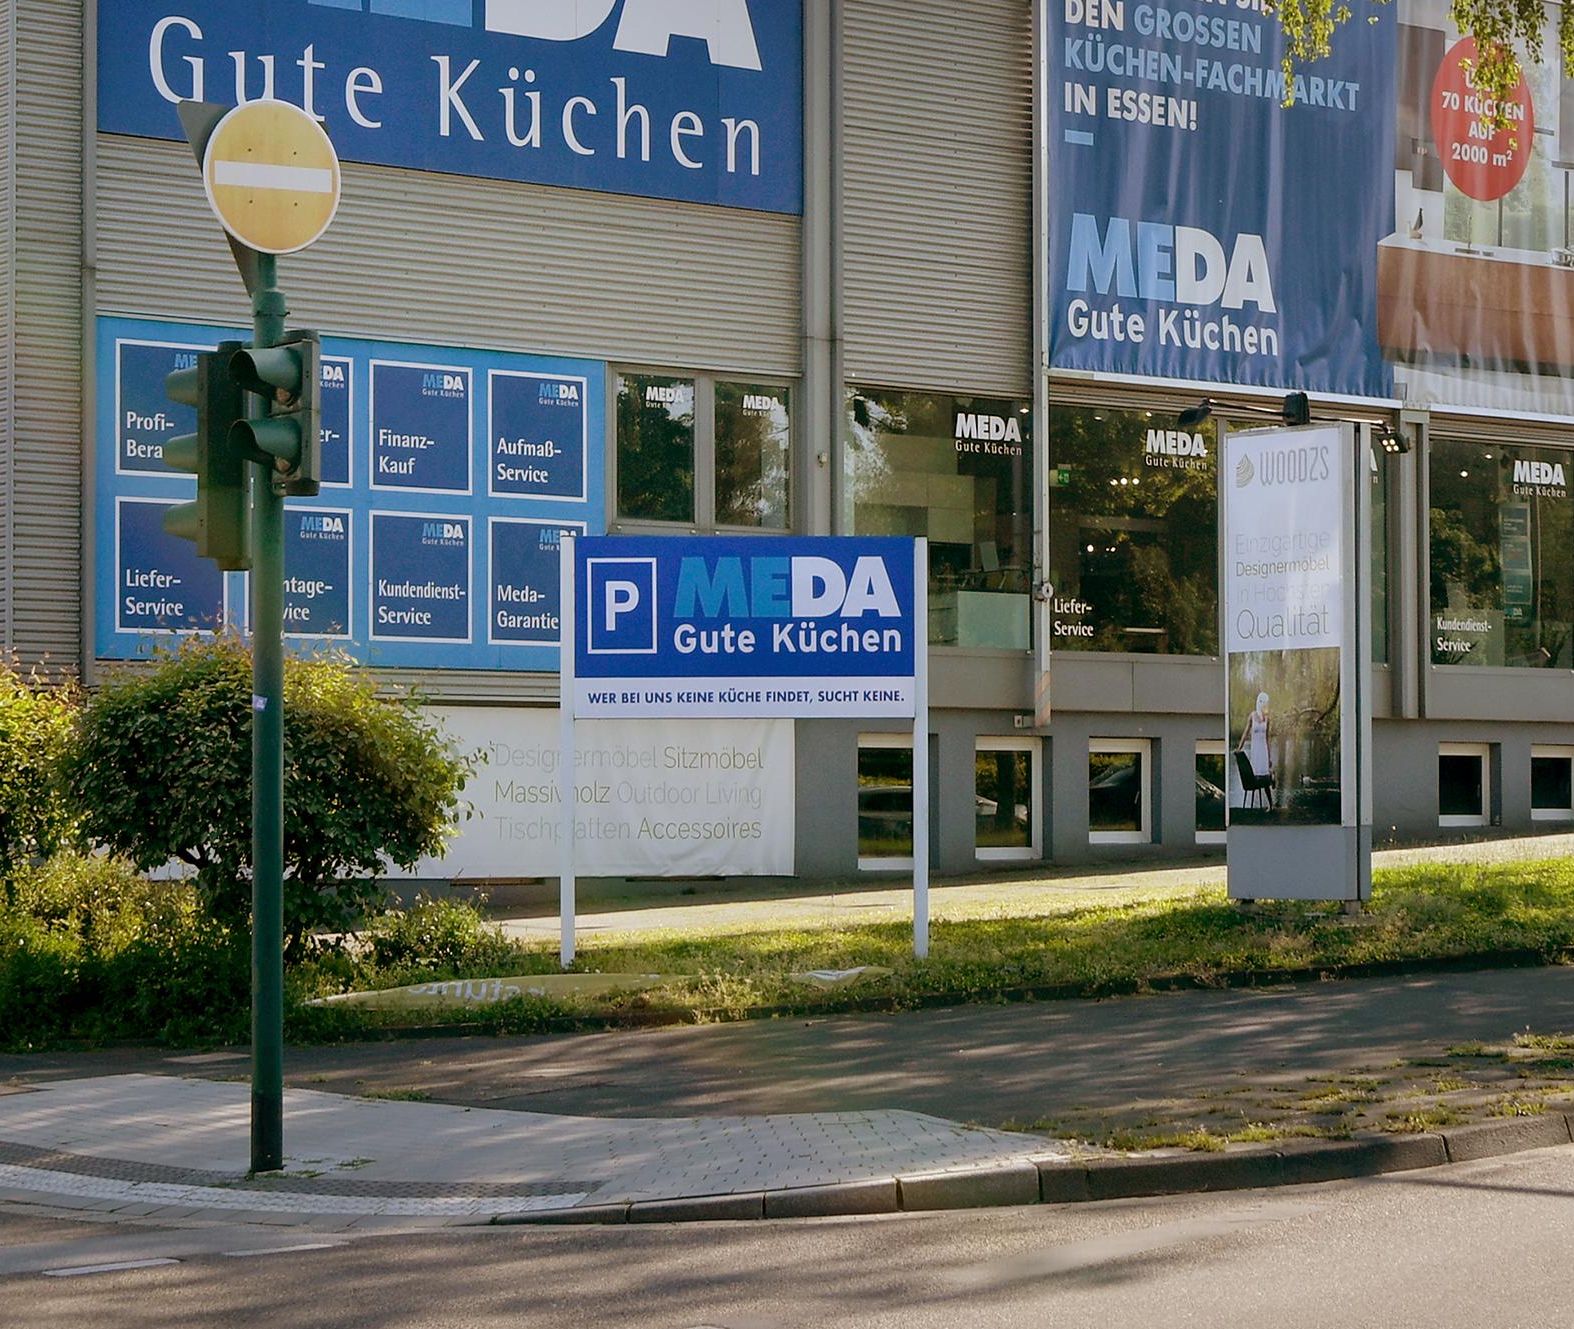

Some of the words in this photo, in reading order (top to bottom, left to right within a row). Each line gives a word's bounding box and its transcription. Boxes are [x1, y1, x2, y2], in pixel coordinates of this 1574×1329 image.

[1134, 4, 1261, 54] GROSSEN
[1065, 33, 1360, 112] KÜCHEN-FACHMARKT
[149, 15, 382, 129] Gute
[430, 54, 761, 175] Küchen
[1442, 92, 1460, 110] 70
[1065, 82, 1096, 115] IN
[1107, 88, 1198, 131] ESSEN!
[1469, 121, 1496, 141] AUF
[1452, 143, 1488, 164] 2000
[1066, 213, 1277, 313] MEDA
[1068, 299, 1145, 343] Gute
[1159, 308, 1278, 356] Küchen
[321, 366, 344, 382] DA
[423, 373, 464, 391] MEDA
[422, 388, 438, 397] Gute
[441, 389, 464, 398] Küchen
[539, 383, 579, 401] MEDA
[539, 397, 554, 406] Gute
[556, 398, 579, 407] Küchen
[646, 386, 684, 402] MEDA
[743, 395, 779, 411] MEDA
[126, 411, 174, 431] Profi-
[955, 412, 1021, 443] MEDA
[126, 439, 163, 459] Bera
[379, 428, 435, 450] Finanz-
[497, 437, 562, 458] Aufmaß-
[955, 440, 980, 453] Gute
[984, 441, 1022, 456] Küchen
[1146, 429, 1206, 457] MEDA
[379, 456, 416, 475] Kauf
[497, 463, 549, 484] Service
[1145, 456, 1169, 468] Gute
[1172, 457, 1207, 471] Küchen
[1259, 446, 1329, 486] WOODZS
[1513, 460, 1565, 486] MEDA
[1513, 484, 1533, 497] Gute
[1536, 485, 1567, 498] Küchen
[300, 516, 344, 533] MEDA
[423, 522, 464, 540] MEDA
[300, 531, 317, 540] Gute
[319, 531, 345, 540] Küchen
[1236, 530, 1331, 558] Einzigartige
[539, 542, 555, 551] Gute
[1236, 556, 1330, 579] Designermöbel
[126, 569, 182, 589] Liefer-
[283, 578, 333, 599] ntage-
[673, 556, 902, 618] MEDA
[378, 579, 466, 601] Kundendienst-
[497, 585, 545, 603] Meda-
[126, 596, 184, 617] Service
[378, 606, 432, 626] Service
[605, 580, 640, 632] P
[1054, 598, 1092, 615] Liefer-
[497, 610, 559, 629] Garantie
[1054, 620, 1094, 637] Service
[1236, 604, 1329, 640] Qualität
[1437, 617, 1492, 633] Kundendienst-
[674, 623, 755, 653] Gute
[773, 621, 902, 653] Küchen
[1437, 639, 1472, 653] Service
[587, 692, 617, 704] WER
[621, 691, 641, 704] BEI
[645, 691, 672, 704] UNS
[677, 690, 714, 703] KEINE
[719, 688, 761, 703] KÜCHE
[766, 690, 813, 704] FINDET,
[818, 689, 859, 703] SUCHT
[863, 689, 905, 703] KEINE.
[664, 746, 764, 769] Sitzmöbel
[617, 780, 700, 805] Outdoor
[706, 782, 762, 809] Living
[637, 817, 762, 840] Accessoires
